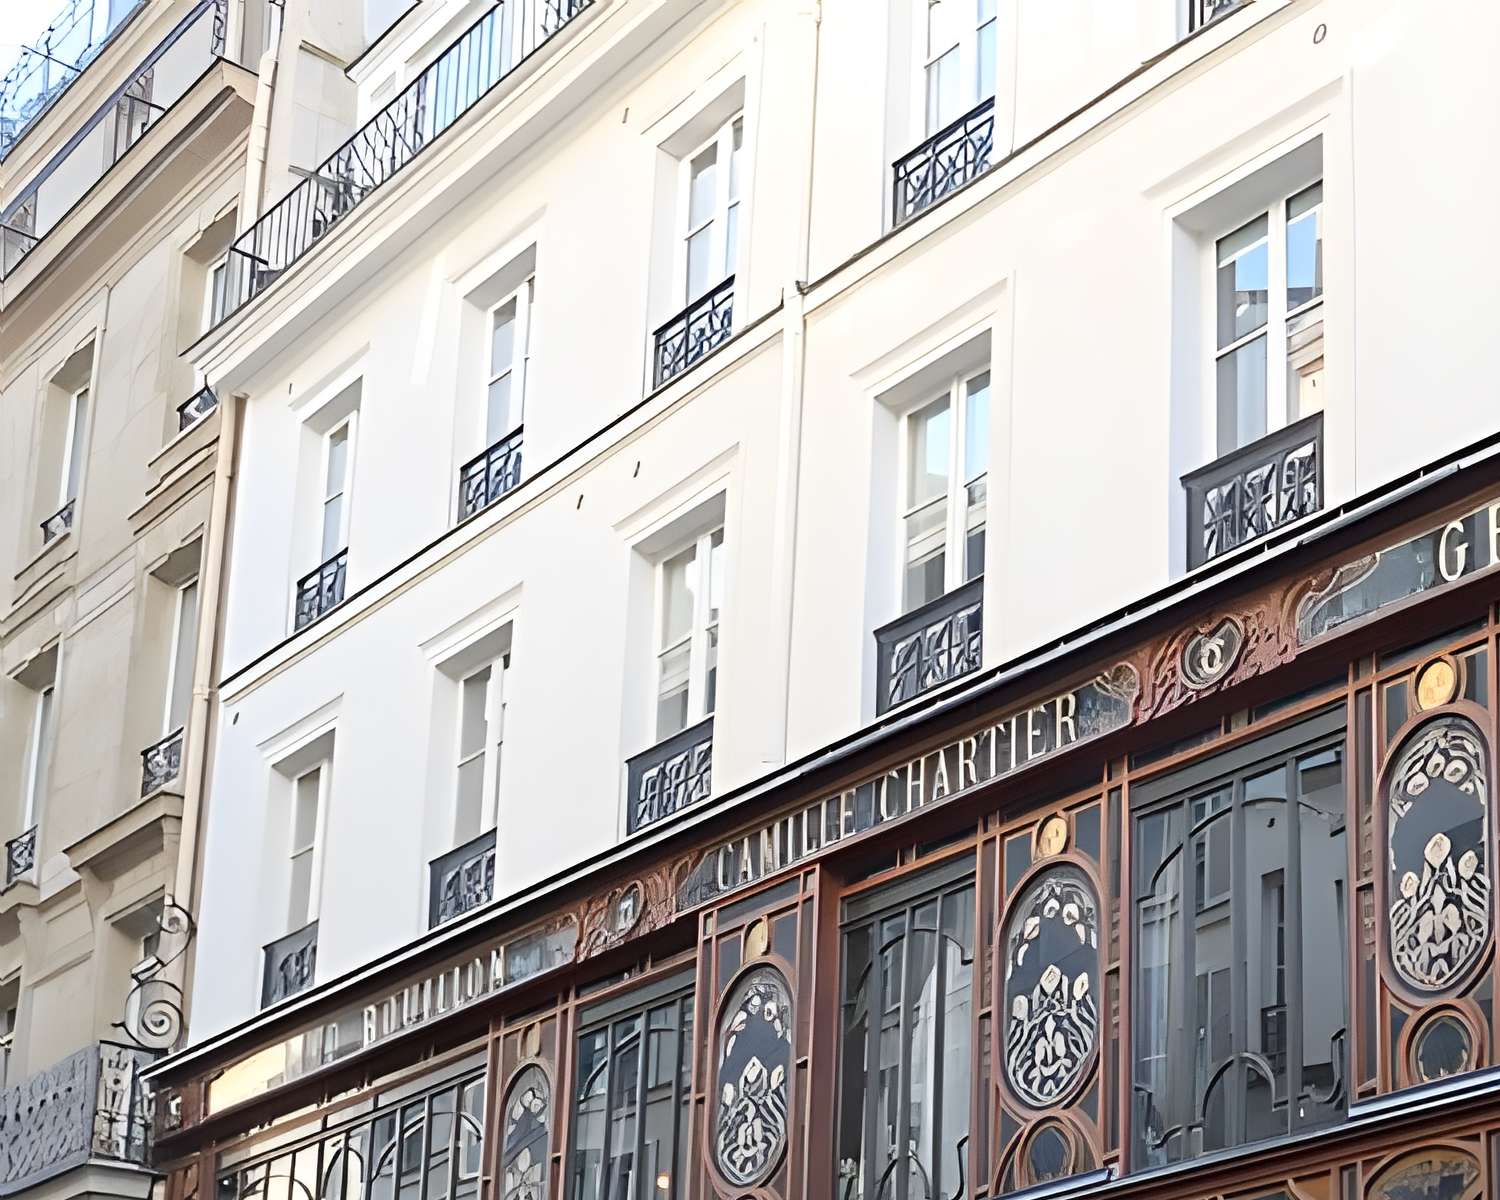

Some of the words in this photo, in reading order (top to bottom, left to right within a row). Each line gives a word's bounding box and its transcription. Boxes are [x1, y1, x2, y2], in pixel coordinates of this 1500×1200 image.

[718, 787, 858, 891] CAMILLE
[880, 693, 1078, 822] CHARTIER
[361, 945, 506, 1050] BOUILLON
